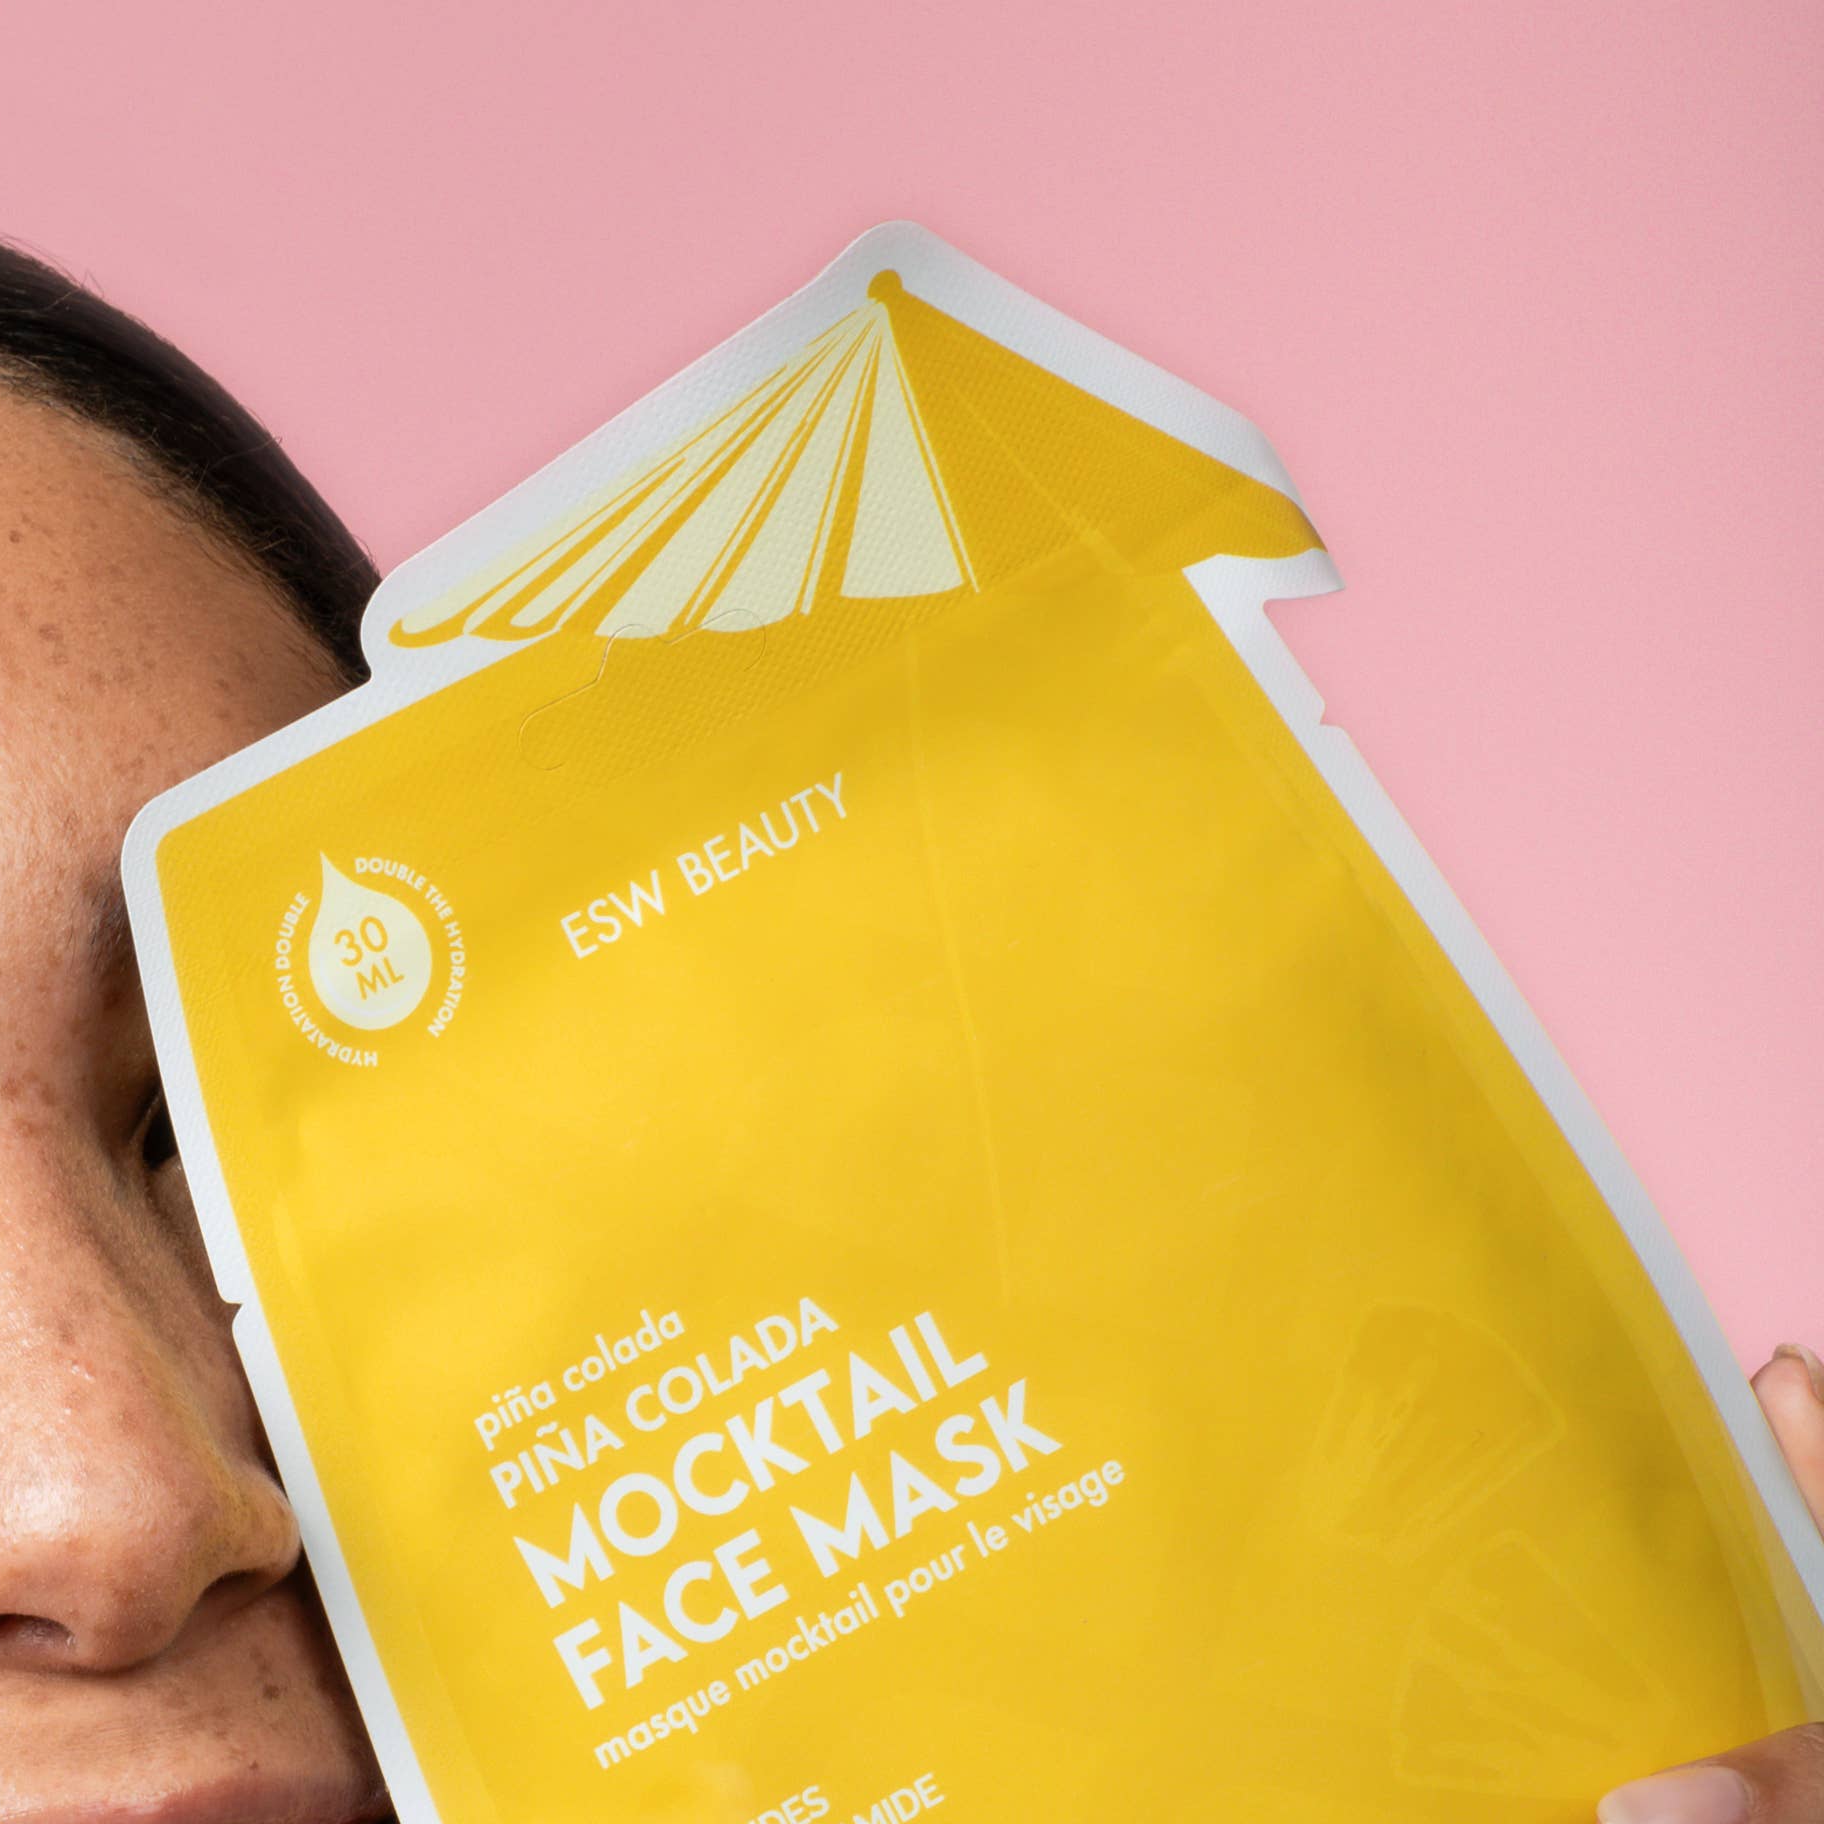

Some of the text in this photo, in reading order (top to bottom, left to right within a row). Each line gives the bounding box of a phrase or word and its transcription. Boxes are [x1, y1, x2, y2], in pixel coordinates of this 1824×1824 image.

[334, 915, 389, 967] 30
[354, 856, 466, 1038] DOUBLE THE HYDRATION
[560, 771, 849, 959] ESW BEAUTY
[275, 891, 378, 1067] HYDRATATION DOUBLE
[354, 956, 405, 1000] ML
[474, 1308, 685, 1450] piña colada
[489, 1297, 839, 1509] PIÑA COLADA
[513, 1312, 989, 1609] MOCKTAIL
[553, 1377, 1064, 1710] FACE MASK
[594, 1458, 1125, 1769] masque mocktail pour le visage
